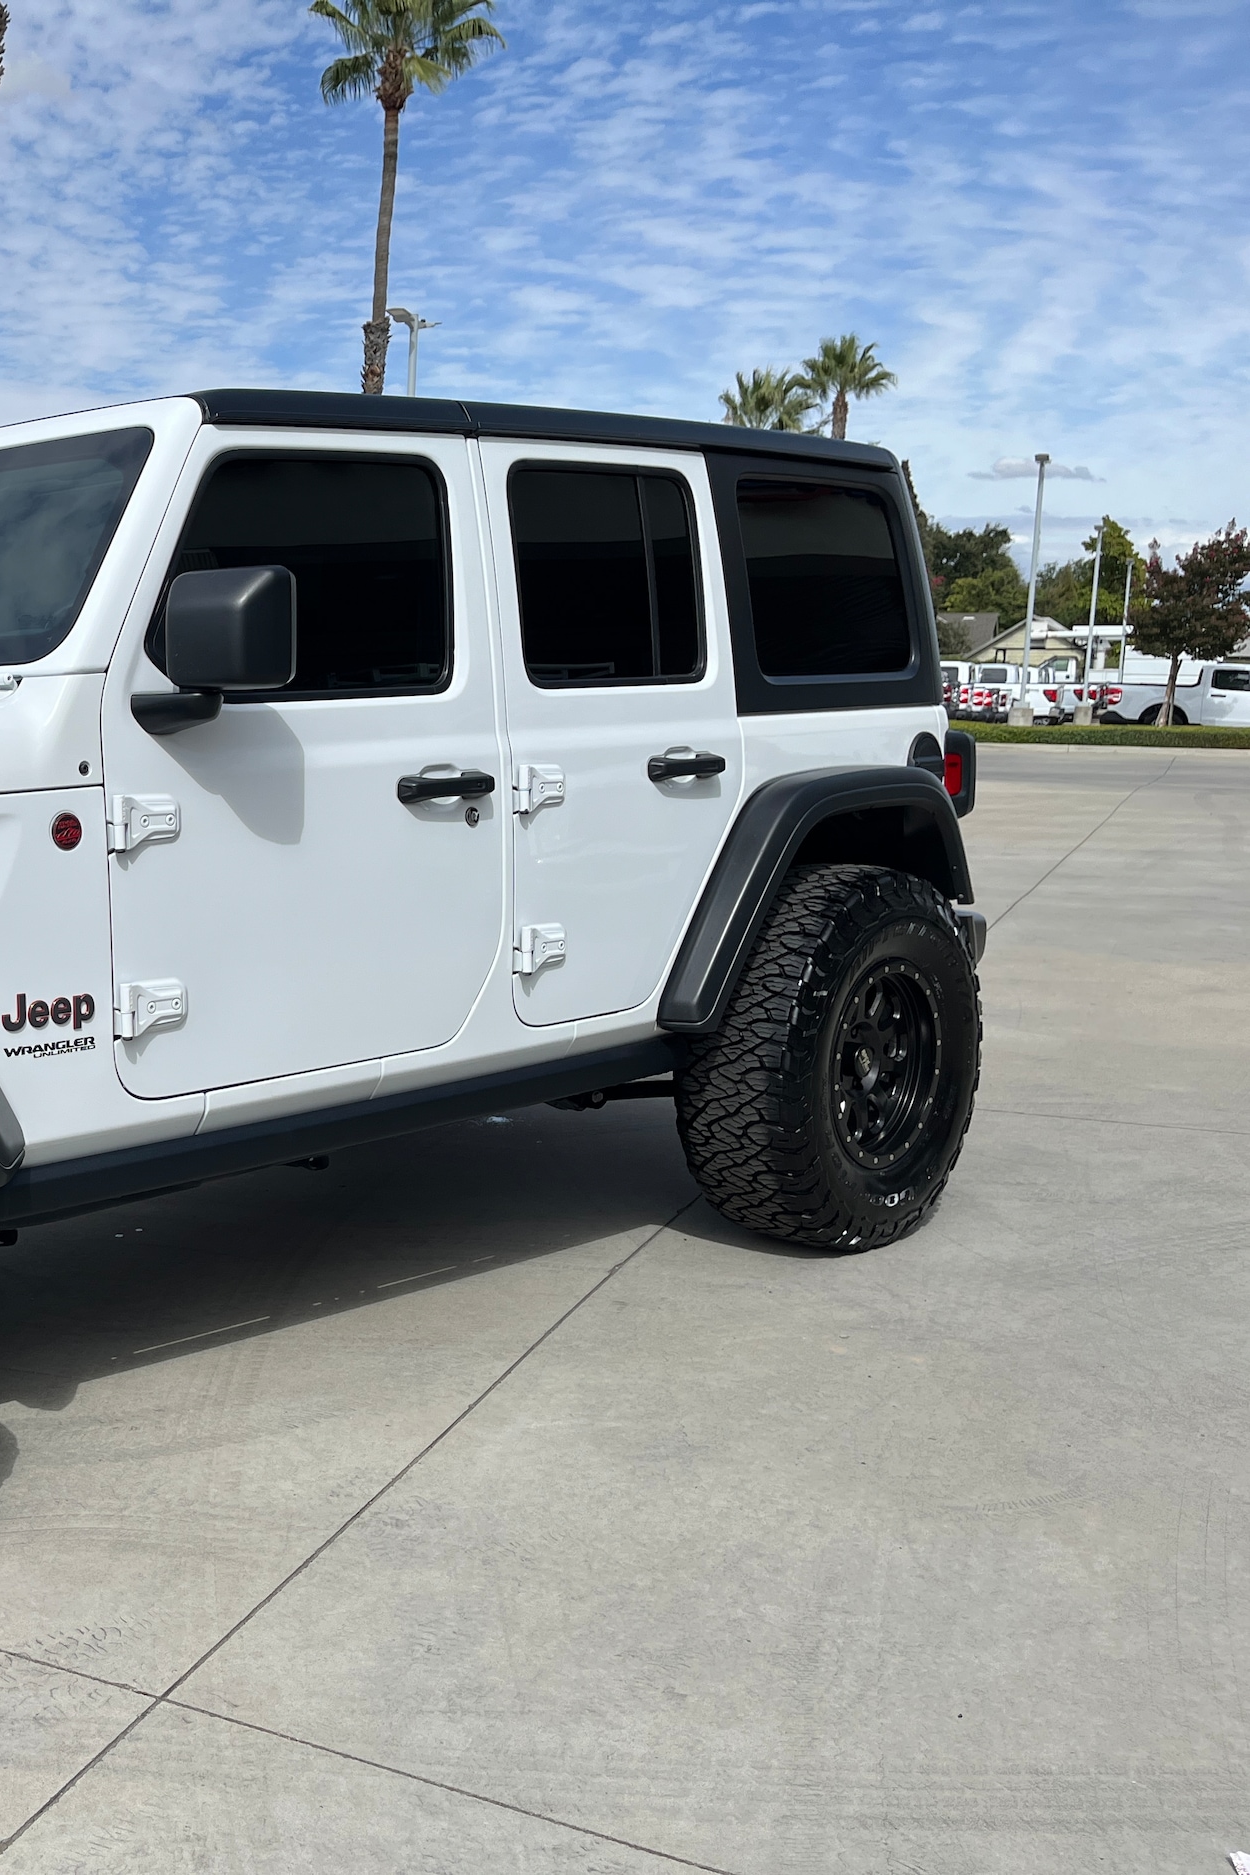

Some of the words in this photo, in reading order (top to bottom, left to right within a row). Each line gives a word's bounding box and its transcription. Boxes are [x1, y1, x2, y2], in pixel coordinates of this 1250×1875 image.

[2, 993, 95, 1031] Jeep
[3, 1036, 96, 1057] WRANGLER
[33, 1045, 96, 1058] UNLIMITED
